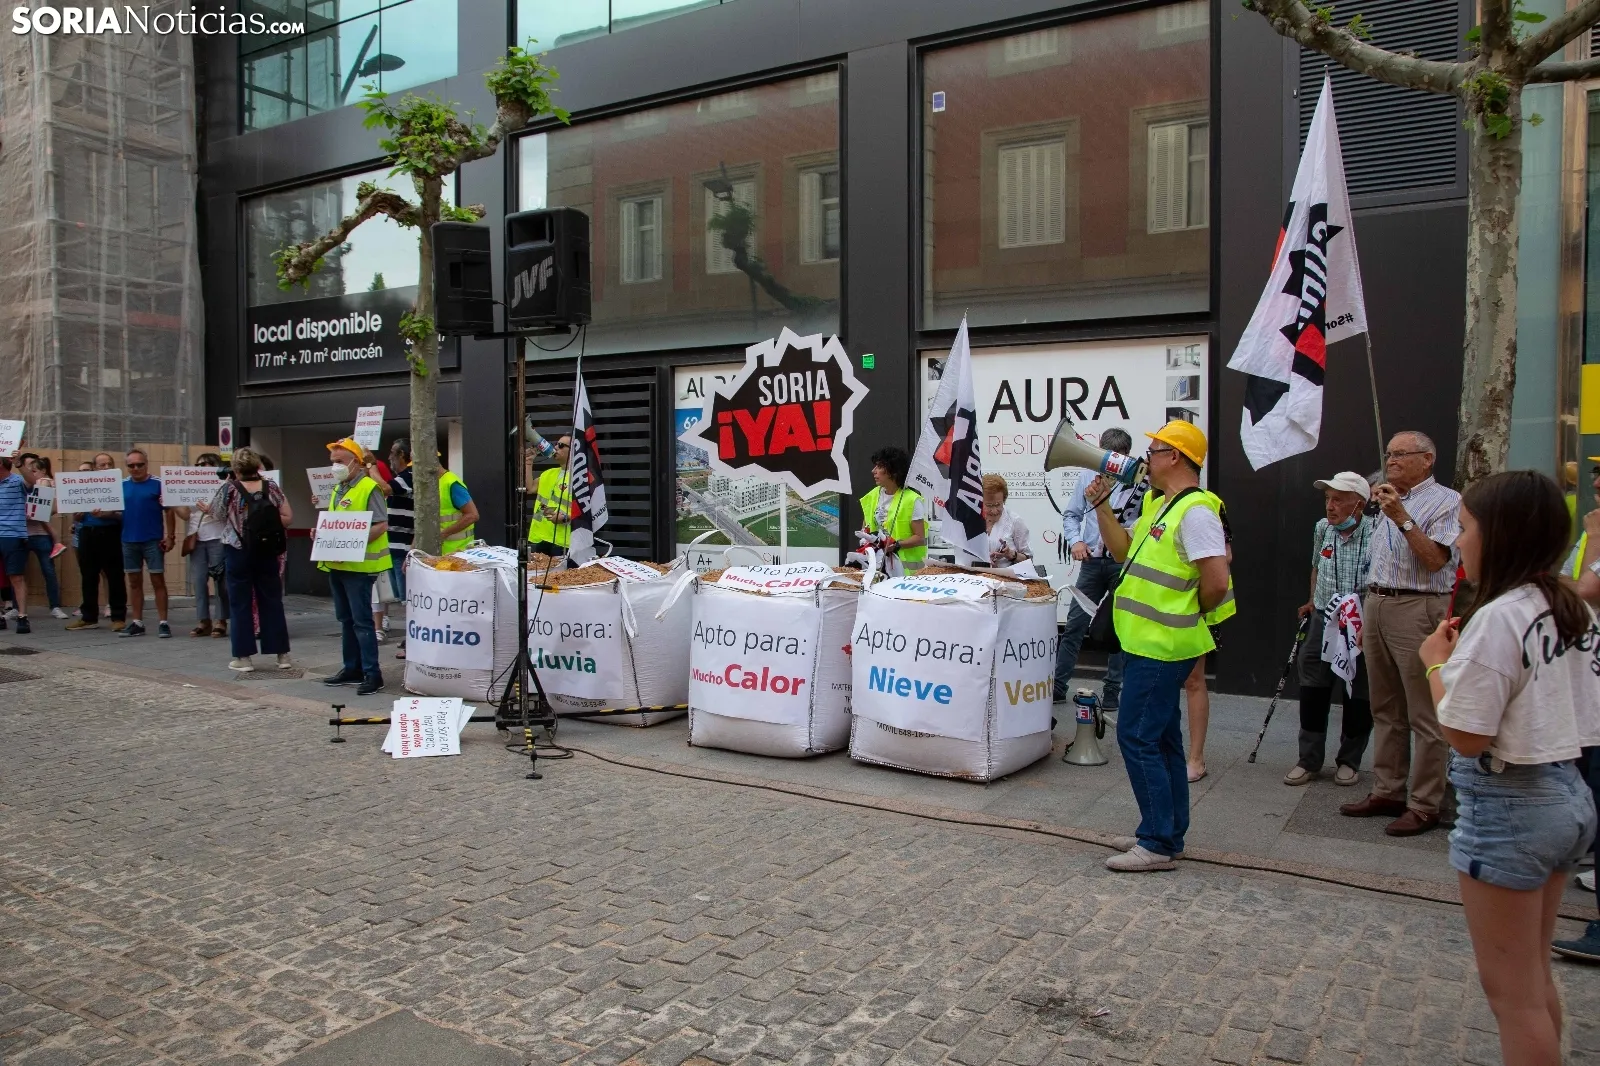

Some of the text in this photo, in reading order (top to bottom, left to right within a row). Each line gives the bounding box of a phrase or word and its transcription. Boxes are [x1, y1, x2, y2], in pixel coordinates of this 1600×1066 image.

[511, 255, 553, 309] JVF
[254, 311, 383, 344] local disponible
[255, 353, 271, 367] 177
[290, 354, 297, 365] +
[299, 349, 312, 364] 70
[330, 342, 383, 362] almacén
[758, 370, 830, 406] SORIA
[988, 375, 1129, 423] AURA
[717, 400, 833, 460] ¡YA!
[62, 477, 76, 485] Sin
[68, 487, 112, 496] perdemos
[61, 495, 120, 505] muchas vidas
[319, 518, 367, 530] Autovías
[315, 537, 364, 549] Finalización
[697, 554, 712, 566] A+
[725, 574, 763, 588] Mucho
[893, 582, 958, 596] Nieve
[406, 588, 485, 616] Apto para:
[408, 619, 481, 646] Granizo
[529, 617, 612, 642] pto para:
[694, 620, 807, 656] Apto para:
[856, 622, 983, 666] Apto para:
[1003, 637, 1045, 668] Apto
[692, 663, 806, 696] Mucho Calor
[868, 665, 953, 705] Nieve
